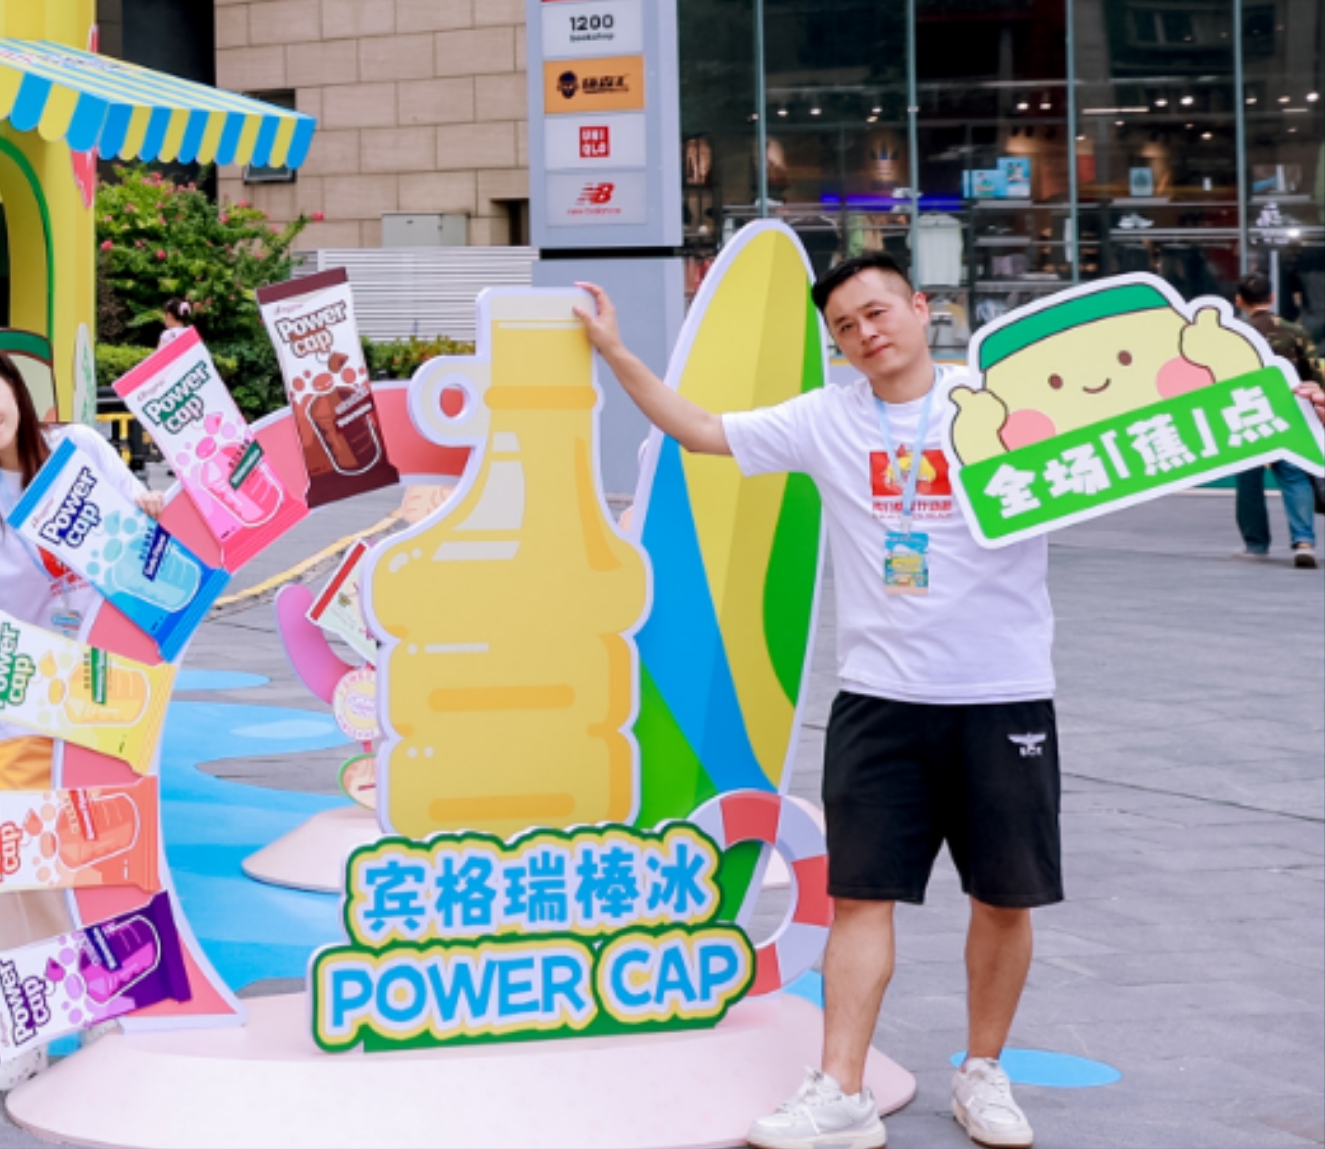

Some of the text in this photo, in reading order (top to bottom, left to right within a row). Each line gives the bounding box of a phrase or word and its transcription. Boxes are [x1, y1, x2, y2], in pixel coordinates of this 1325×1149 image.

[569, 14, 615, 32] 1200
[275, 299, 347, 344] Power
[291, 328, 334, 358] cap
[142, 359, 212, 428] Power
[164, 394, 205, 435] cap
[983, 385, 1290, 521] 全场「蕉」点
[38, 465, 98, 546] Power
[65, 501, 102, 549] cap
[8, 653, 37, 707] cap
[0, 820, 24, 876] cap
[363, 843, 707, 934] 宾格瑞棒冰
[22, 974, 51, 1027] cap
[330, 943, 740, 1029] POWER CAP
